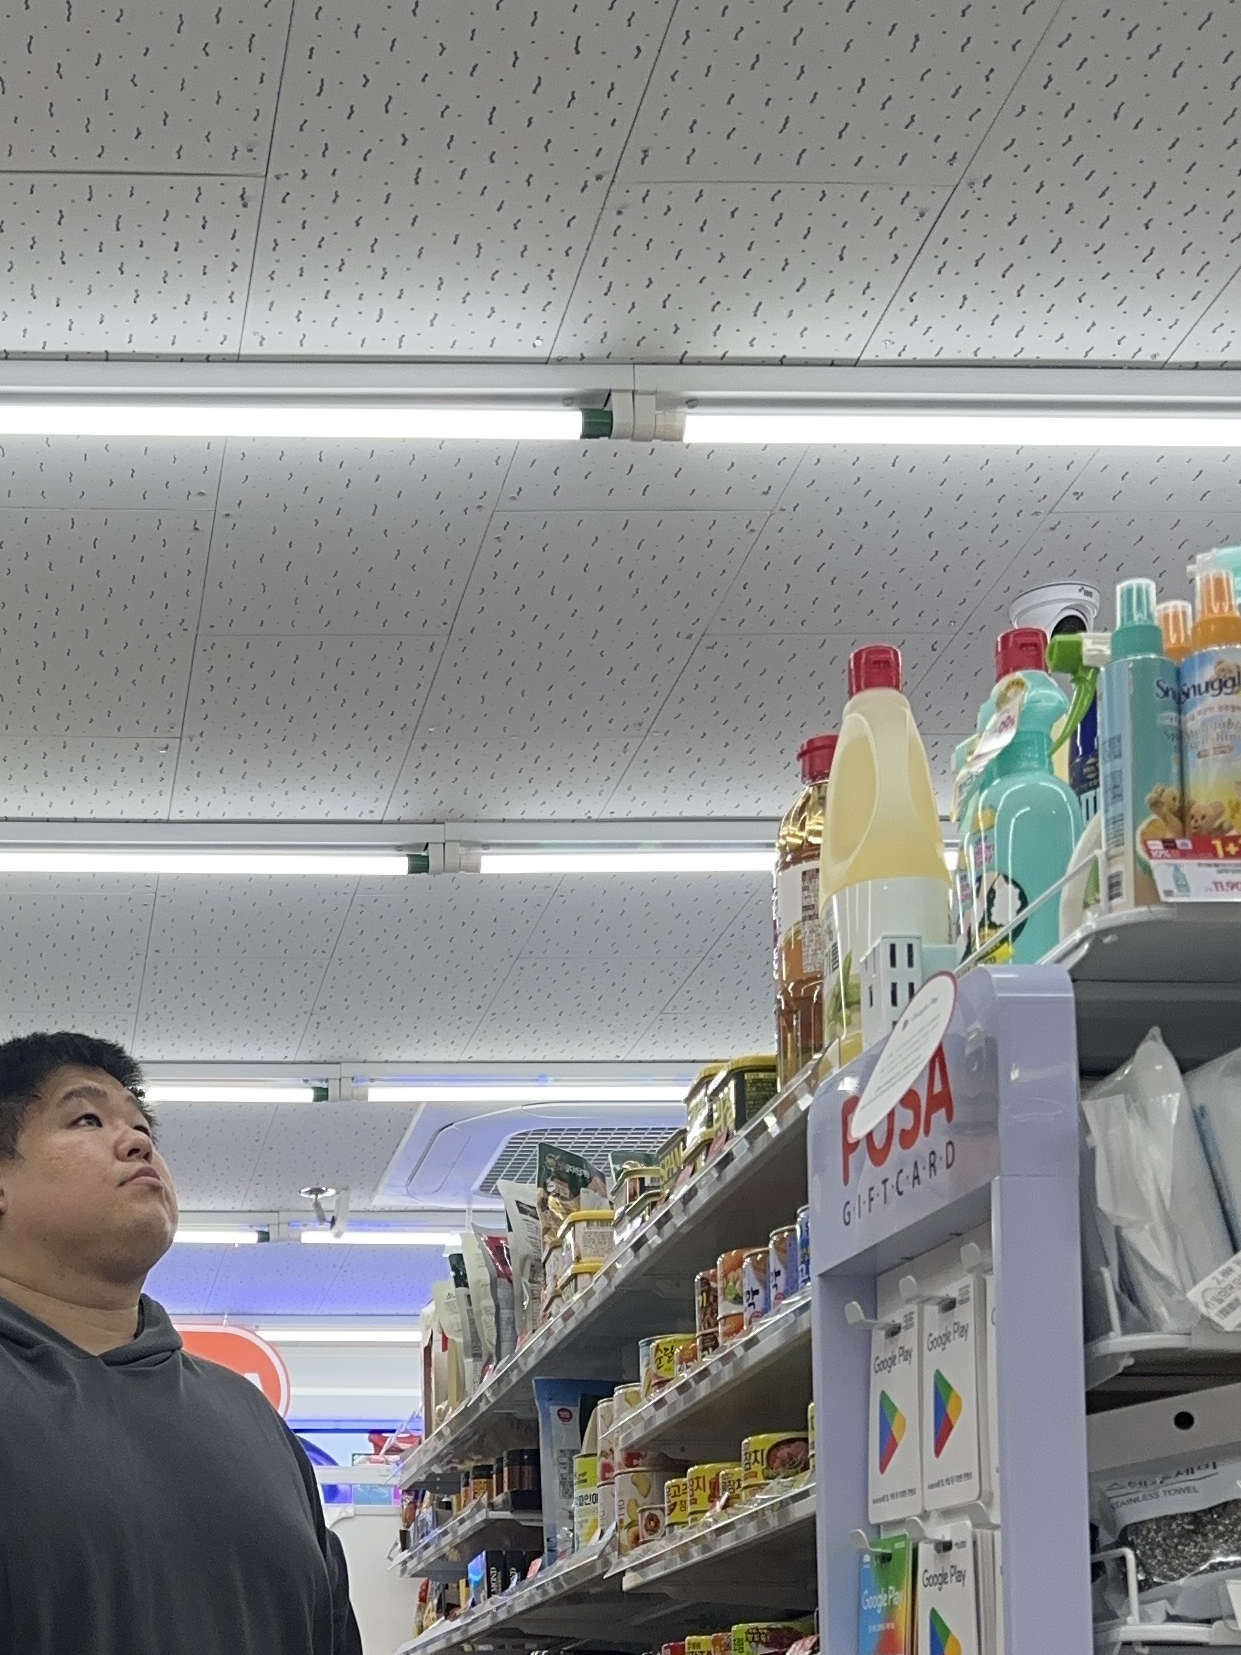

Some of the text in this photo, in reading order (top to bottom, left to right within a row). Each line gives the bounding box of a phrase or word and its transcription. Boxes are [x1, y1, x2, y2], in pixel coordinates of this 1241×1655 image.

[927, 1320, 970, 1353] Google Play
[873, 1351, 896, 1375] Google
[1162, 1485, 1200, 1498] TOWEL
[922, 1564, 967, 1592] Google Play
